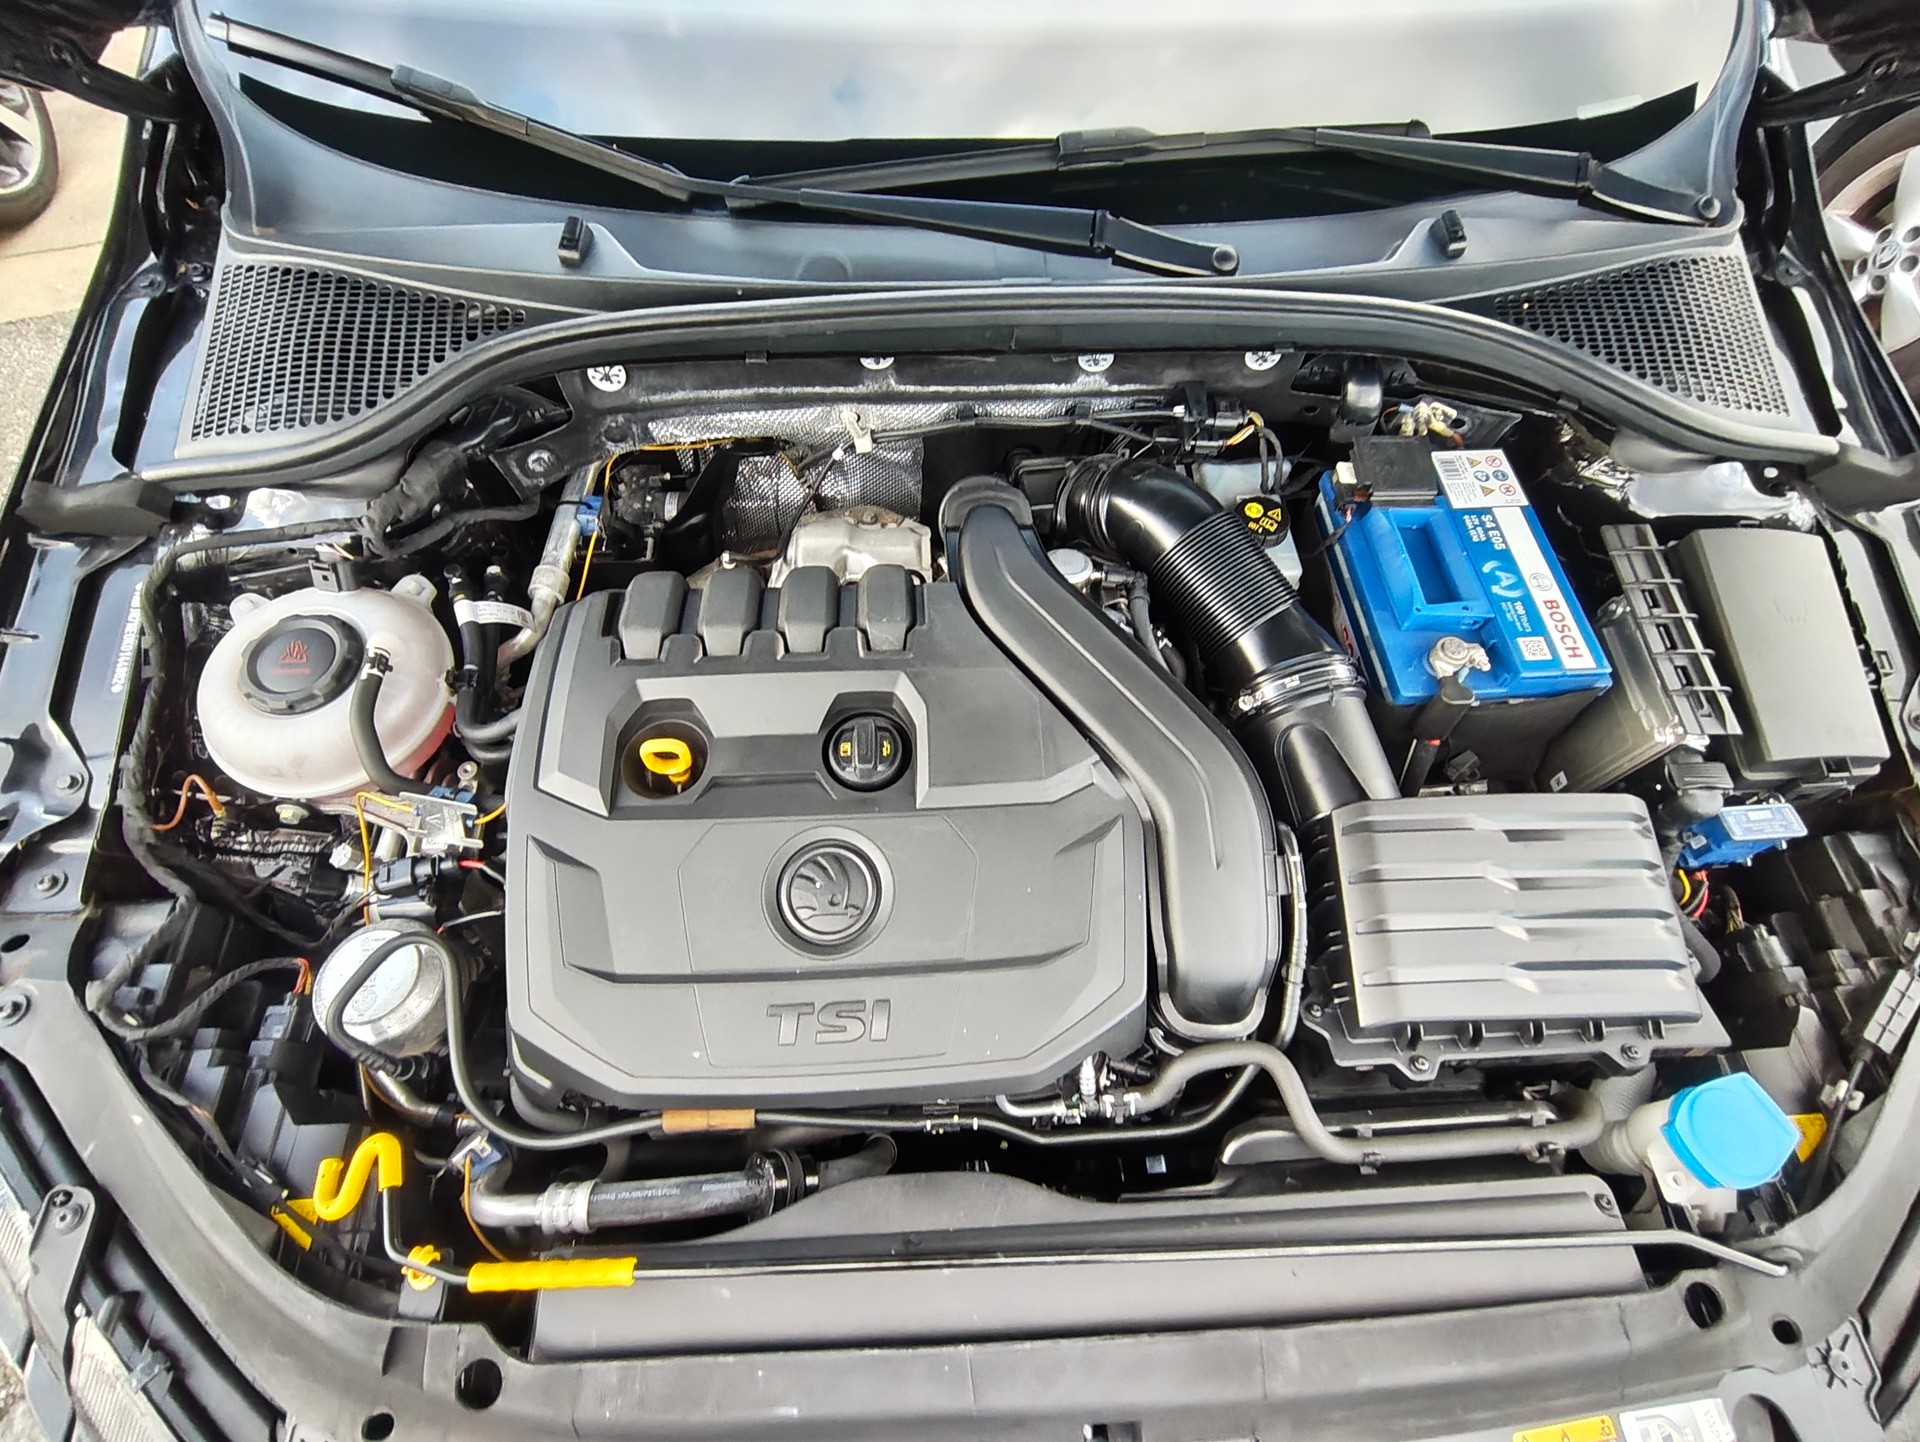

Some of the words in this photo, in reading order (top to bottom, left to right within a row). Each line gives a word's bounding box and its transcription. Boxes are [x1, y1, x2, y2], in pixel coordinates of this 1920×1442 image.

[1481, 514, 1496, 528] S4
[1488, 530, 1507, 550] E05
[1542, 599, 1584, 659] BOSCH
[766, 998, 892, 1047] TSI
